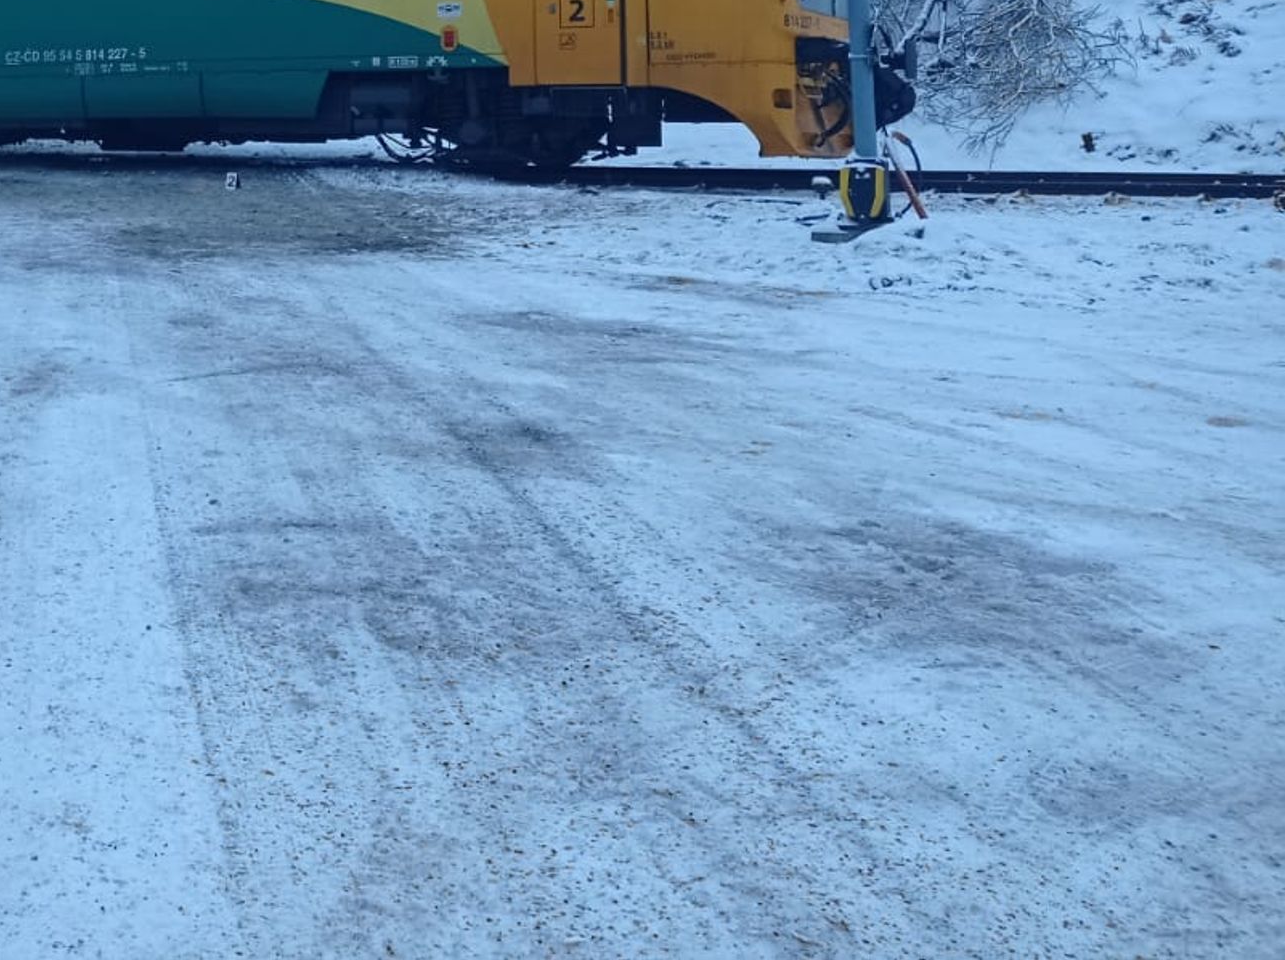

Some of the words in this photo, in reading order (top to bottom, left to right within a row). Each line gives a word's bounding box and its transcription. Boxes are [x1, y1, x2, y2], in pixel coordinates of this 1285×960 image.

[569, 0, 585, 22] 2
[75, 48, 83, 61] 5
[85, 48, 105, 61] 814
